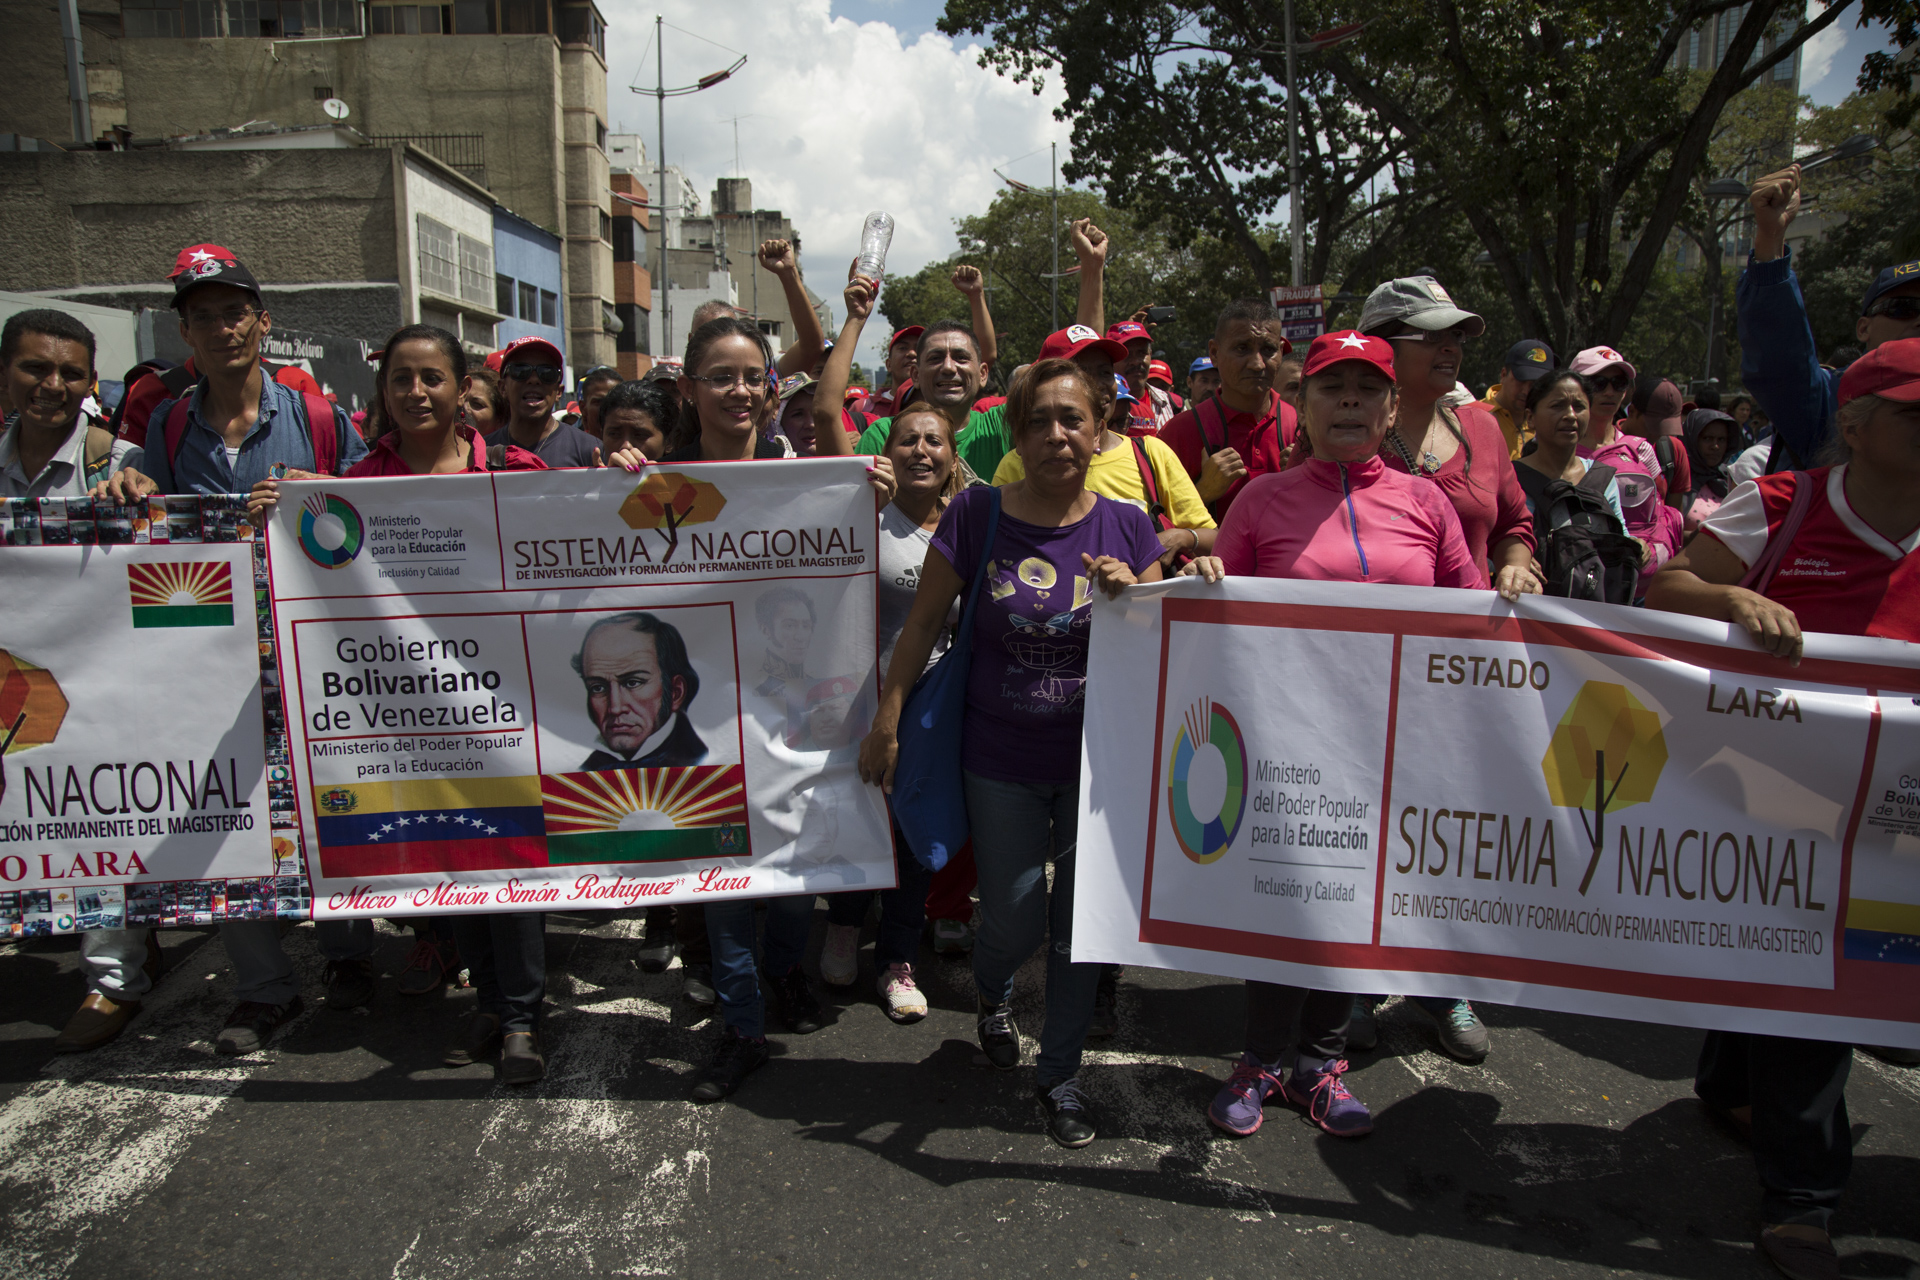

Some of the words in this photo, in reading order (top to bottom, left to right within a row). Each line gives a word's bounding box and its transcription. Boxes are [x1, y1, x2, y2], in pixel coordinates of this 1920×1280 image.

[1283, 290, 1315, 301] FRAUDE
[369, 515, 421, 528] Ministerio
[370, 529, 387, 541] del
[389, 528, 420, 541] Poder
[422, 526, 463, 543] Popular
[371, 546, 395, 558] para
[398, 543, 407, 554] la
[409, 540, 466, 554] Educación
[514, 535, 652, 569] SISTEMA
[691, 526, 864, 561] NACIONAL
[378, 567, 419, 579] Inclusión
[419, 570, 426, 580] y
[427, 566, 460, 577] Calidad
[516, 570, 531, 580] DE
[533, 565, 618, 580] INVESTIGACIÓN
[620, 566, 627, 576] Y
[629, 561, 696, 575] FORMACIÓN
[699, 559, 774, 573] PERMANENTE
[776, 557, 796, 569] DEL
[798, 555, 866, 568] MAGISTERIO
[336, 635, 480, 664] Gobierno
[322, 667, 501, 698] Bolivariano
[1427, 653, 1551, 691] ESTADO
[312, 704, 351, 732] de
[360, 696, 516, 729] Venezuela
[1706, 684, 1803, 723] LARA
[313, 739, 390, 757] Ministerio
[394, 738, 416, 752] del
[420, 737, 461, 752] Poder
[466, 734, 522, 752] Popular
[357, 763, 390, 778] para
[394, 760, 407, 773] la
[411, 758, 484, 773] Educación
[1255, 759, 1321, 786] Ministerio
[24, 758, 251, 818] NACIONAL
[1253, 790, 1274, 813] del
[1277, 792, 1316, 816] Poder
[1318, 794, 1369, 823] Popular
[1875, 804, 1894, 816] de
[38, 820, 134, 841] PERMANENTE
[138, 818, 164, 836] DEL
[168, 814, 254, 835] MAGISTERIO
[1251, 824, 1280, 848] para
[1283, 822, 1294, 846] la
[1298, 823, 1368, 850] Educación
[1868, 820, 1904, 829] Ministerio
[38, 850, 150, 880] LARA
[1396, 806, 1558, 888] SISTEMA
[1617, 825, 1826, 912] NACIONAL
[328, 884, 397, 911] Micro
[495, 877, 561, 905] Simón
[693, 866, 751, 893] Lara
[1254, 875, 1302, 899] Inclusión
[1303, 884, 1312, 903] y
[1314, 881, 1355, 902] Calidad
[1392, 893, 1408, 916] DE
[1412, 894, 1514, 926] INVESTIGACIÓN
[1516, 904, 1525, 927] Y
[1526, 905, 1612, 938] FORMACIÓN
[1615, 915, 1706, 946] PERMANENTE
[1709, 922, 1734, 948] DEL
[1738, 925, 1824, 956] MAGISTERIO
